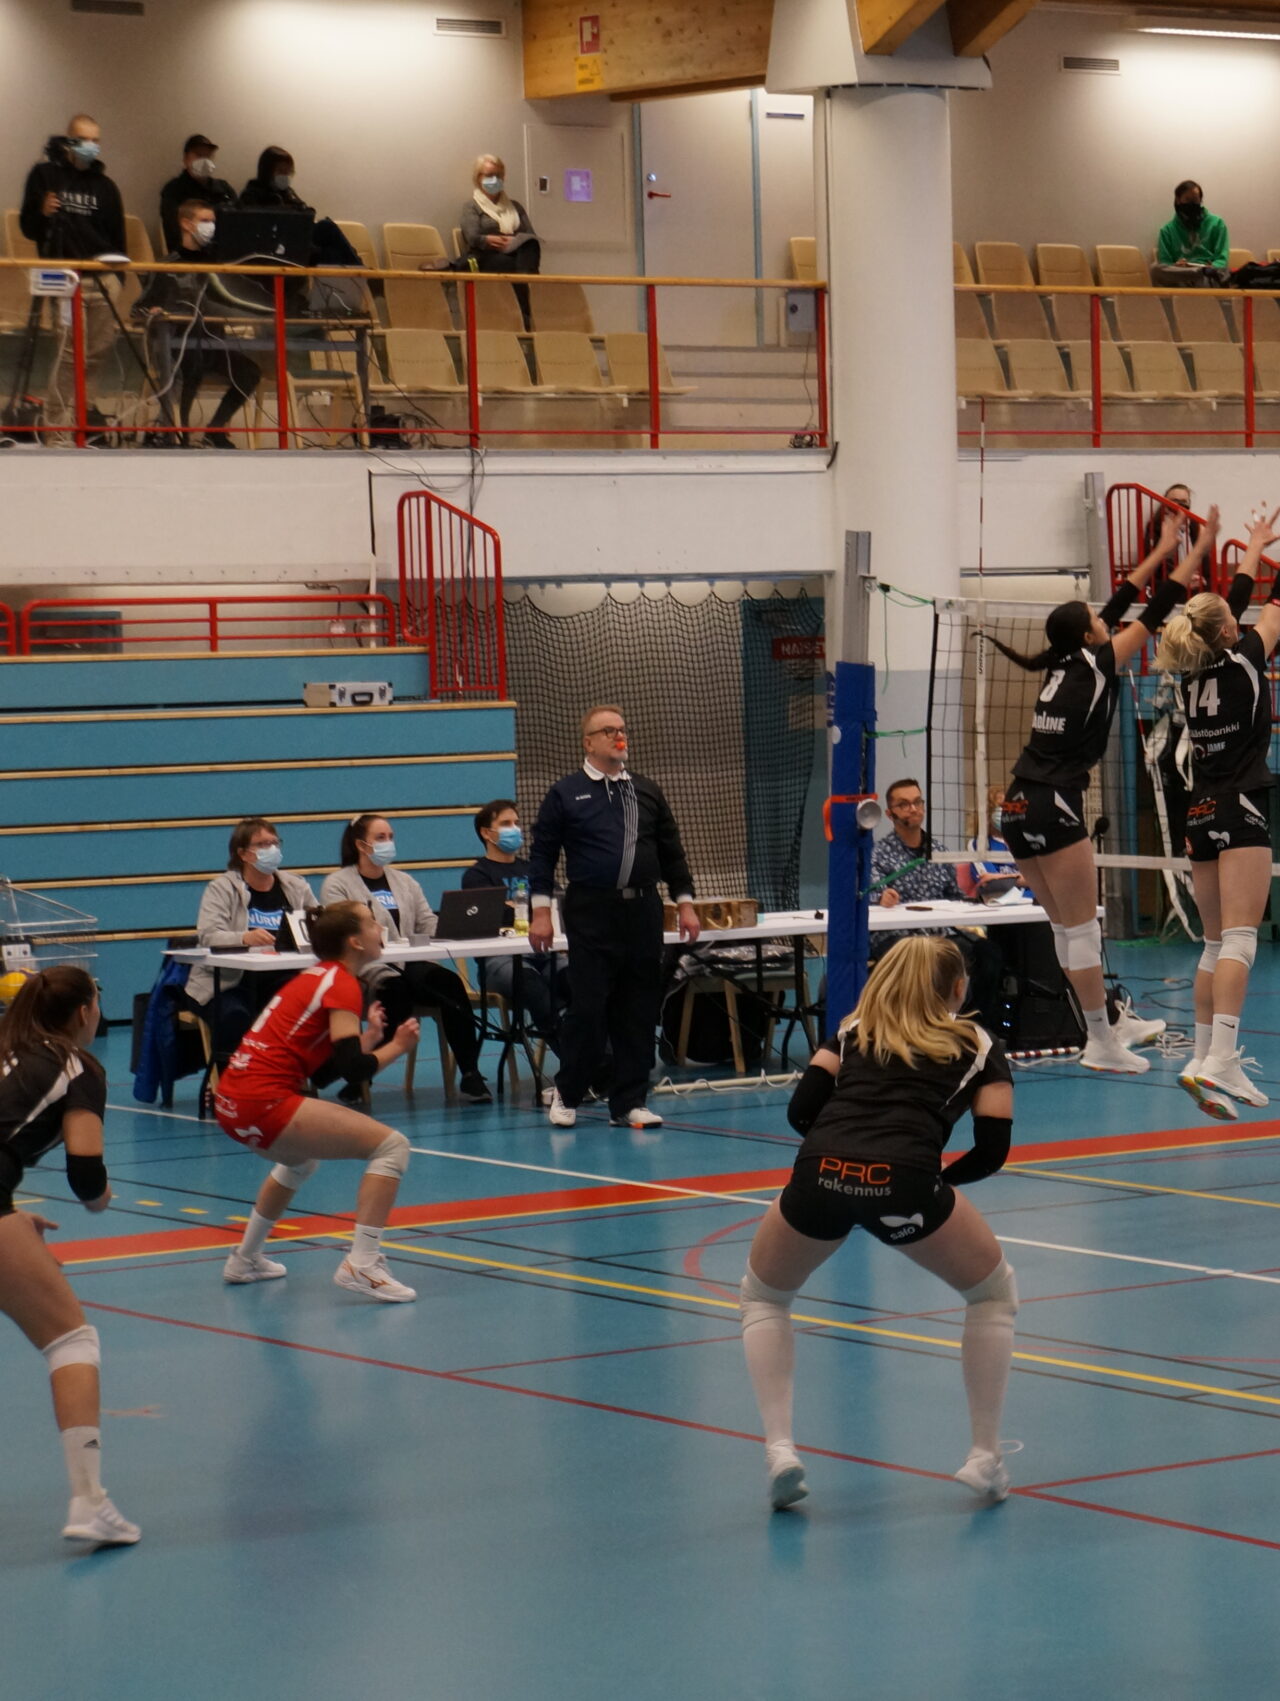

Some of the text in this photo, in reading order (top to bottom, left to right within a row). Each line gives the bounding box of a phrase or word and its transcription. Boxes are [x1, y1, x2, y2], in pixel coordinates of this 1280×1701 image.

[1187, 677, 1221, 718] 14
[820, 1157, 892, 1185] PRC
[817, 1176, 892, 1197] rakennus
[889, 1225, 916, 1241] salo
